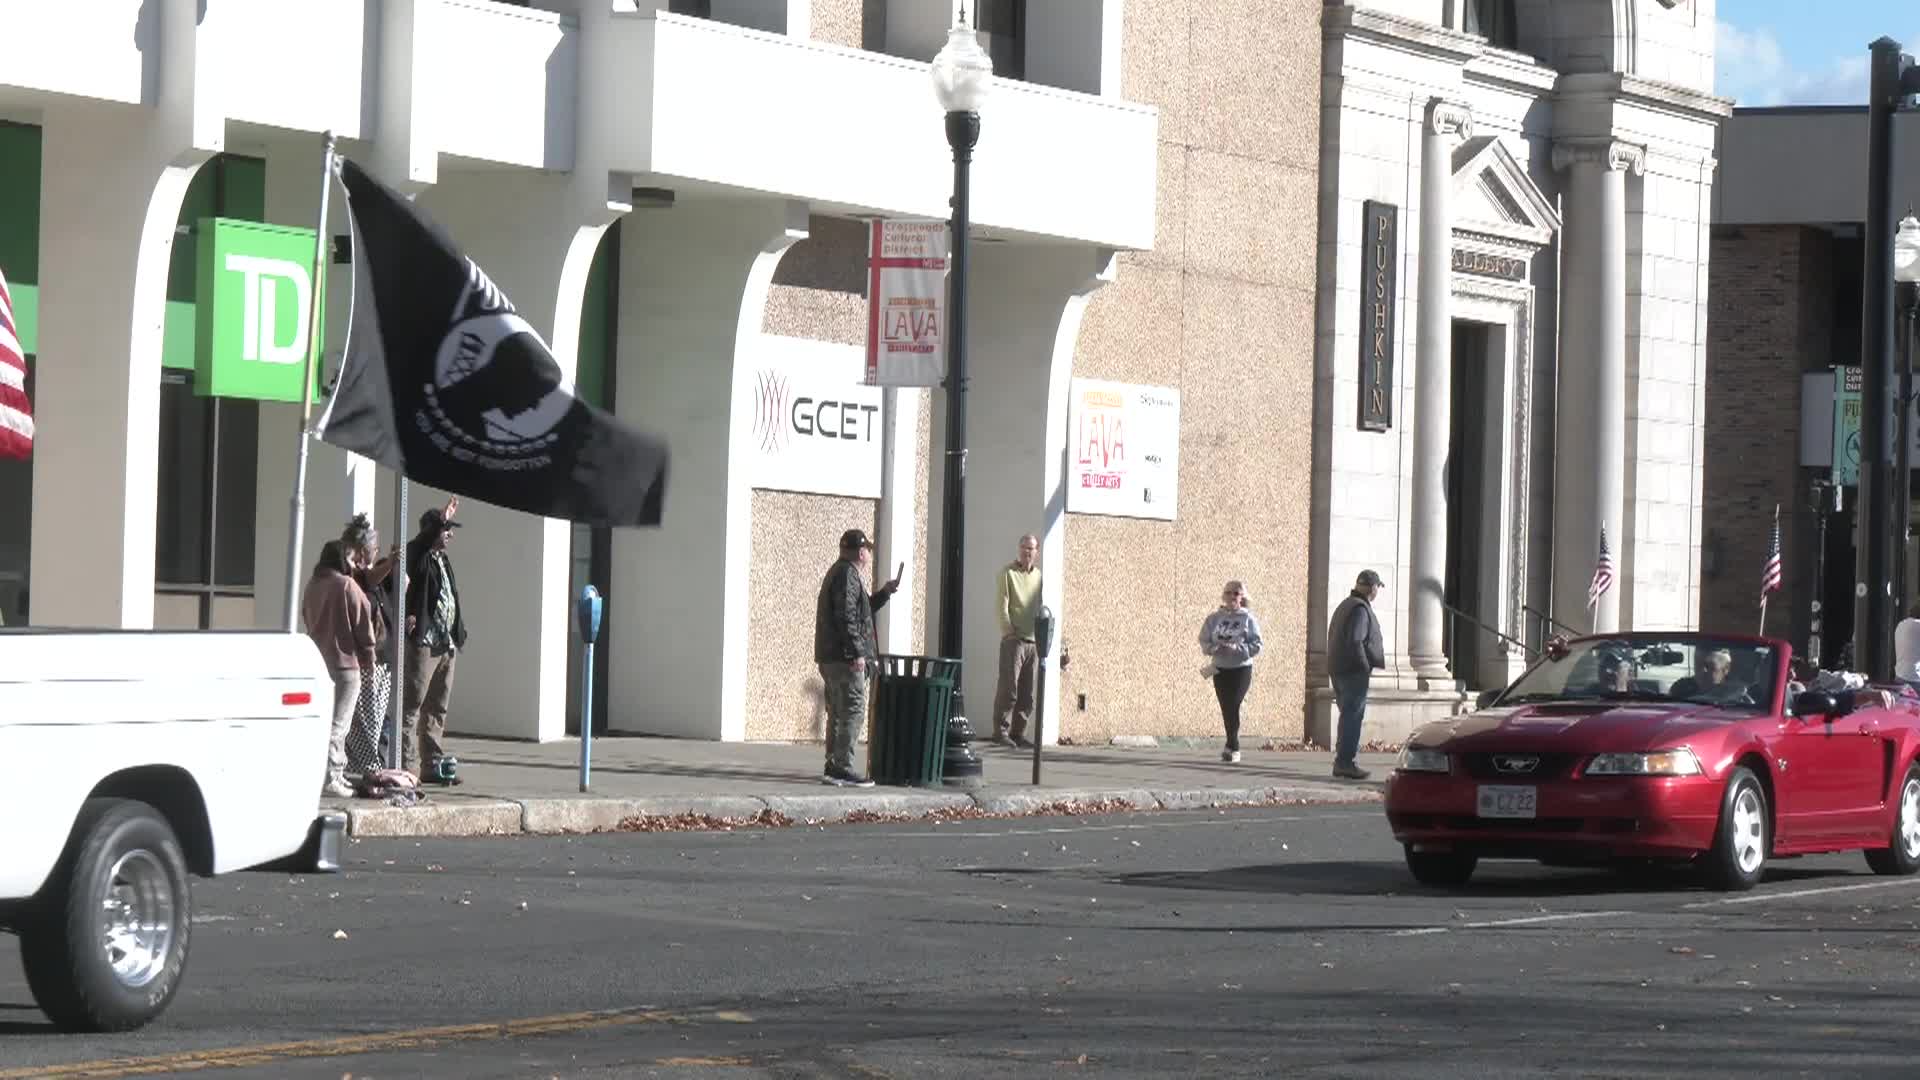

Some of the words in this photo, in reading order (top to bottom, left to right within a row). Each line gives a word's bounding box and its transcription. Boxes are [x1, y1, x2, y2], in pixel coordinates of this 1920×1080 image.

[1451, 248, 1519, 277] ALLERY
[225, 254, 312, 364] TD
[884, 311, 938, 341] LAVA
[1371, 215, 1388, 415] PUSHKIN
[792, 397, 878, 442] GCET
[1079, 415, 1124, 468] LAVA
